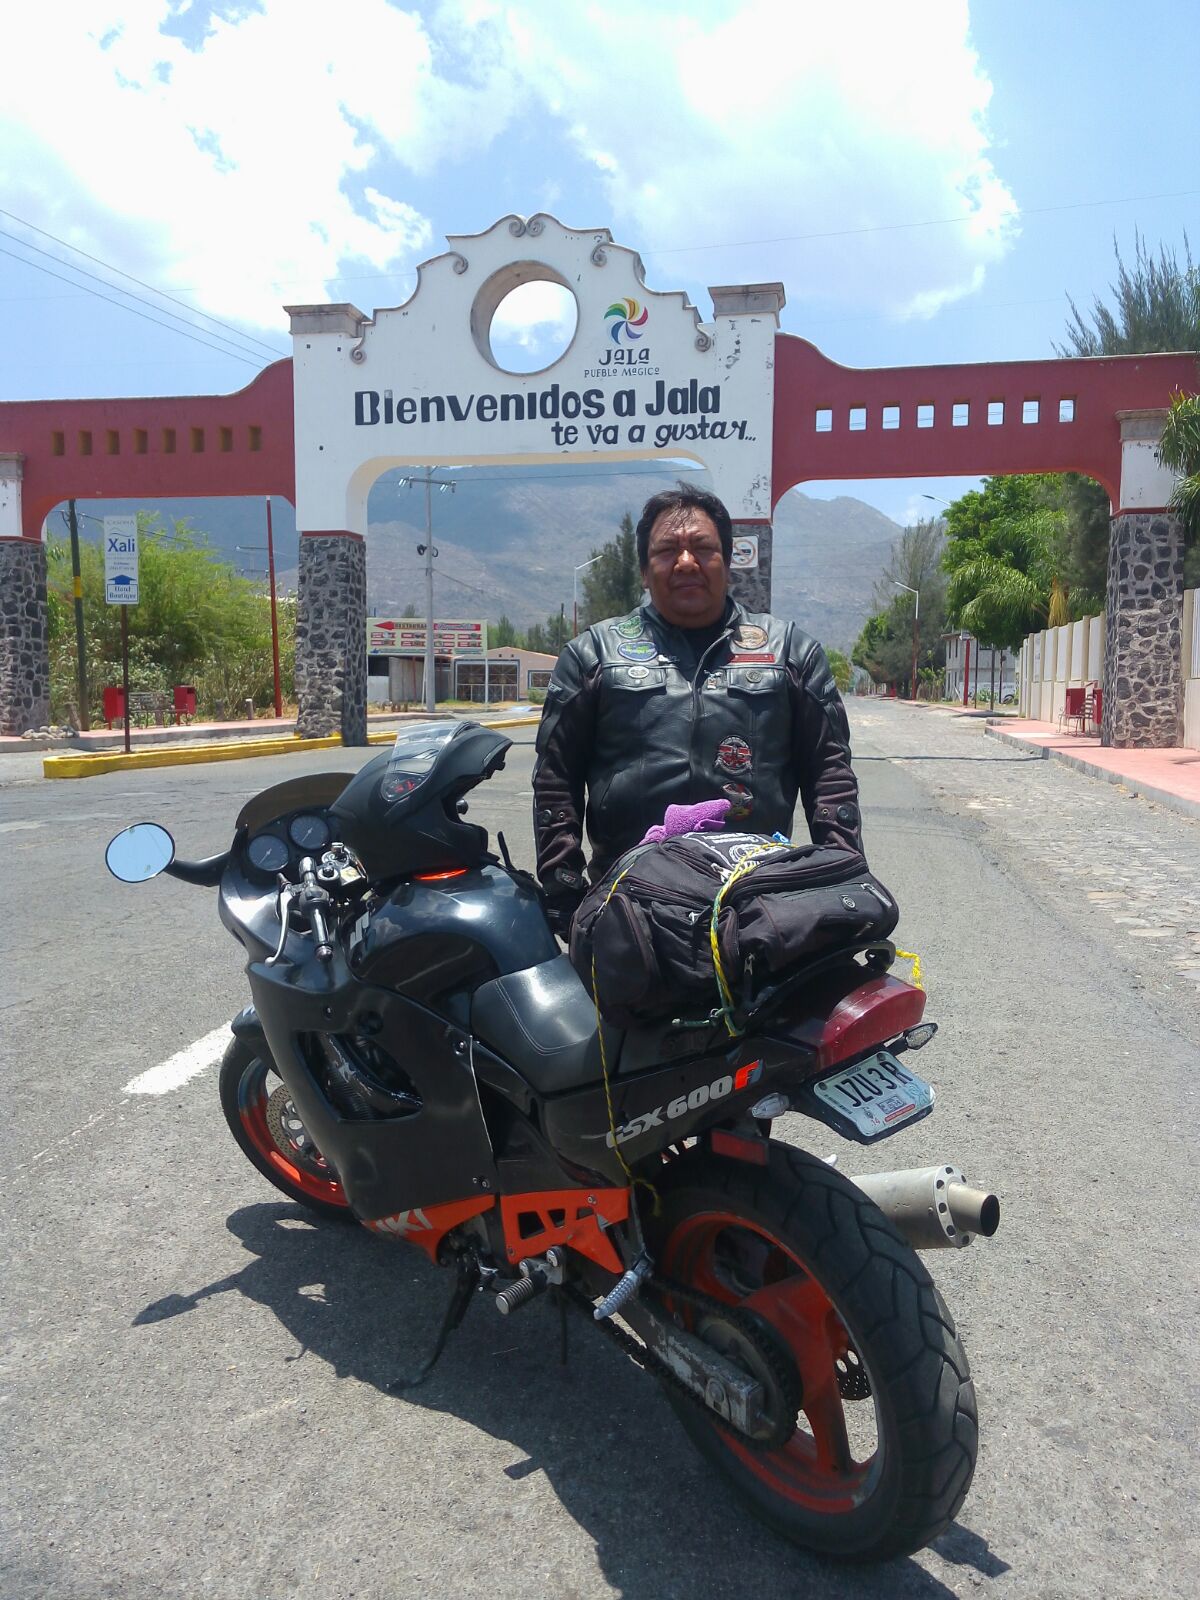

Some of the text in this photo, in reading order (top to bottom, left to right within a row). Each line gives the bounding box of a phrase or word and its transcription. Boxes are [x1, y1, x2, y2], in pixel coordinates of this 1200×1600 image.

[355, 378, 720, 425] Bienvenidos a Jala
[551, 421, 579, 446] te
[586, 424, 620, 445] va
[627, 424, 646, 443] a
[108, 538, 135, 552] Xali
[667, 1075, 733, 1119] 600
[735, 1059, 762, 1090] F
